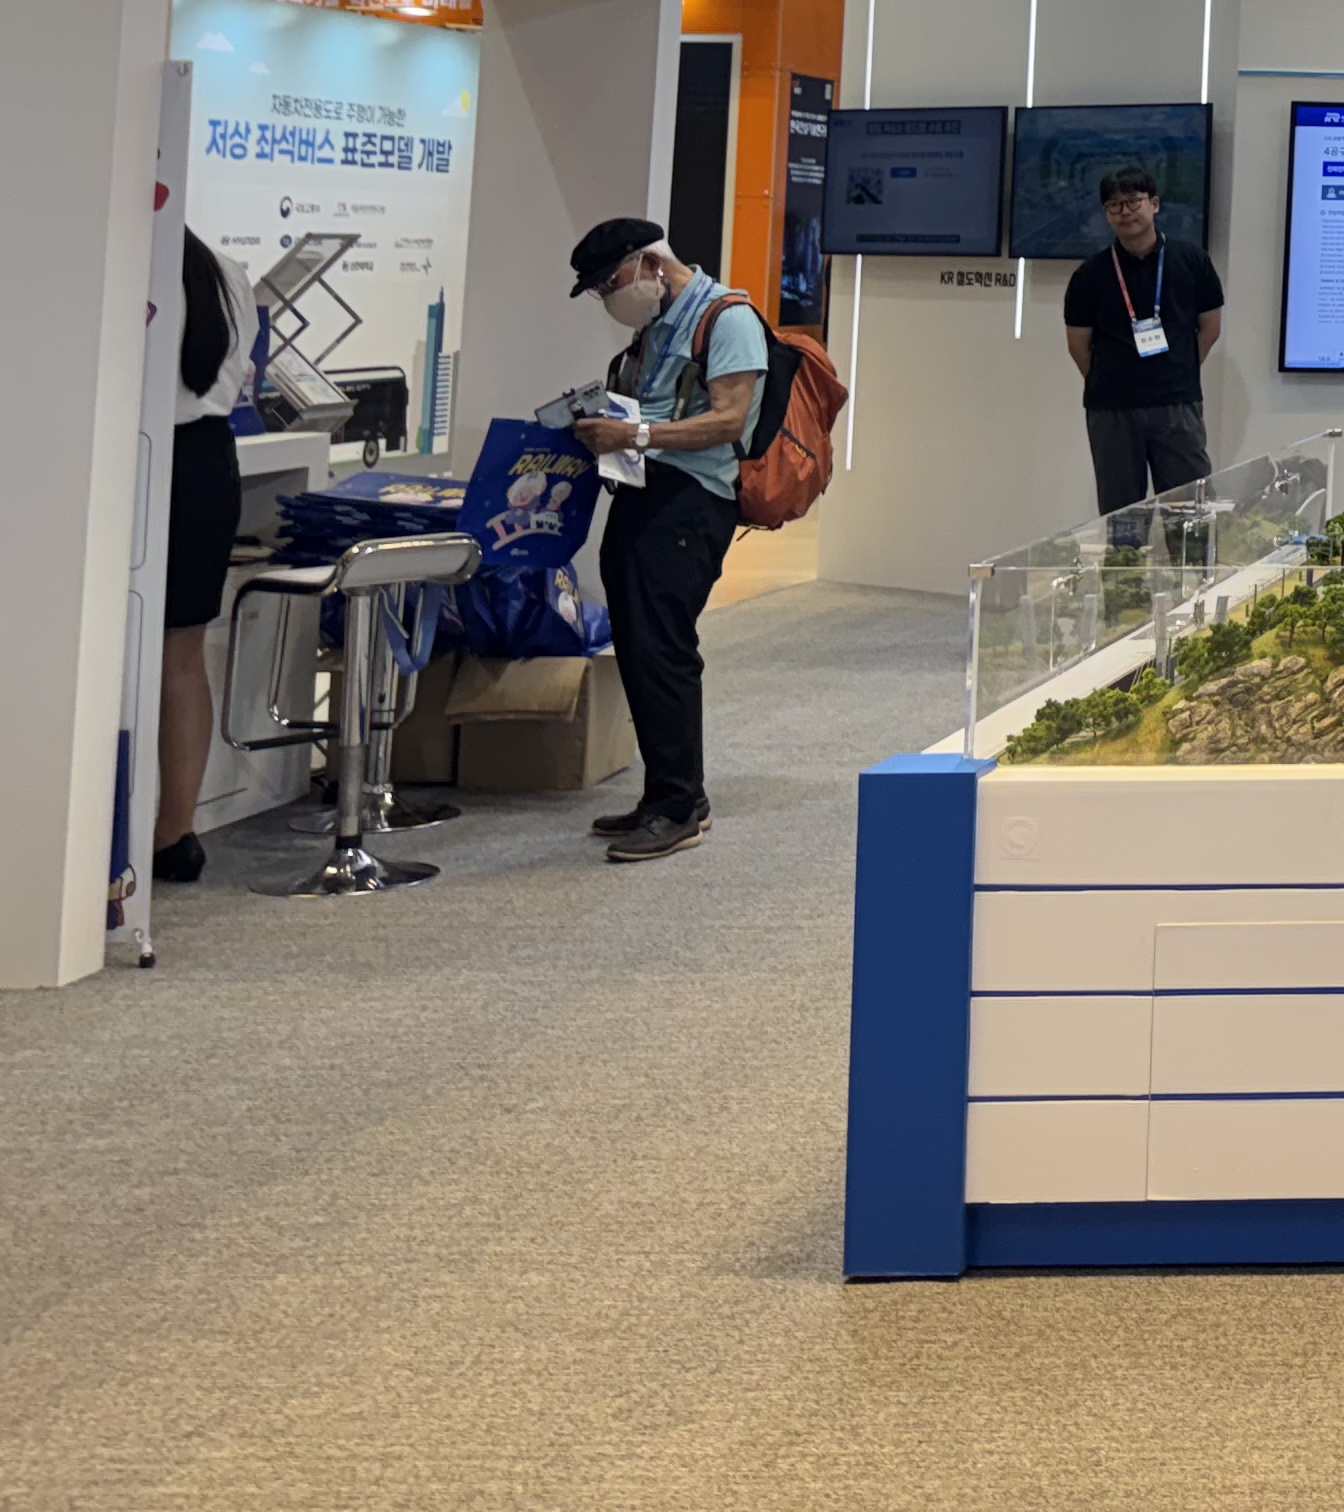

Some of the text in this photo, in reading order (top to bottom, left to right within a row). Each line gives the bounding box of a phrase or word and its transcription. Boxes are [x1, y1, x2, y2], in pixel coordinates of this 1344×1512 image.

[205, 118, 452, 173] 저상 좌석버스 표준모델 개발
[940, 271, 955, 285] KR
[995, 272, 1017, 287] R&D
